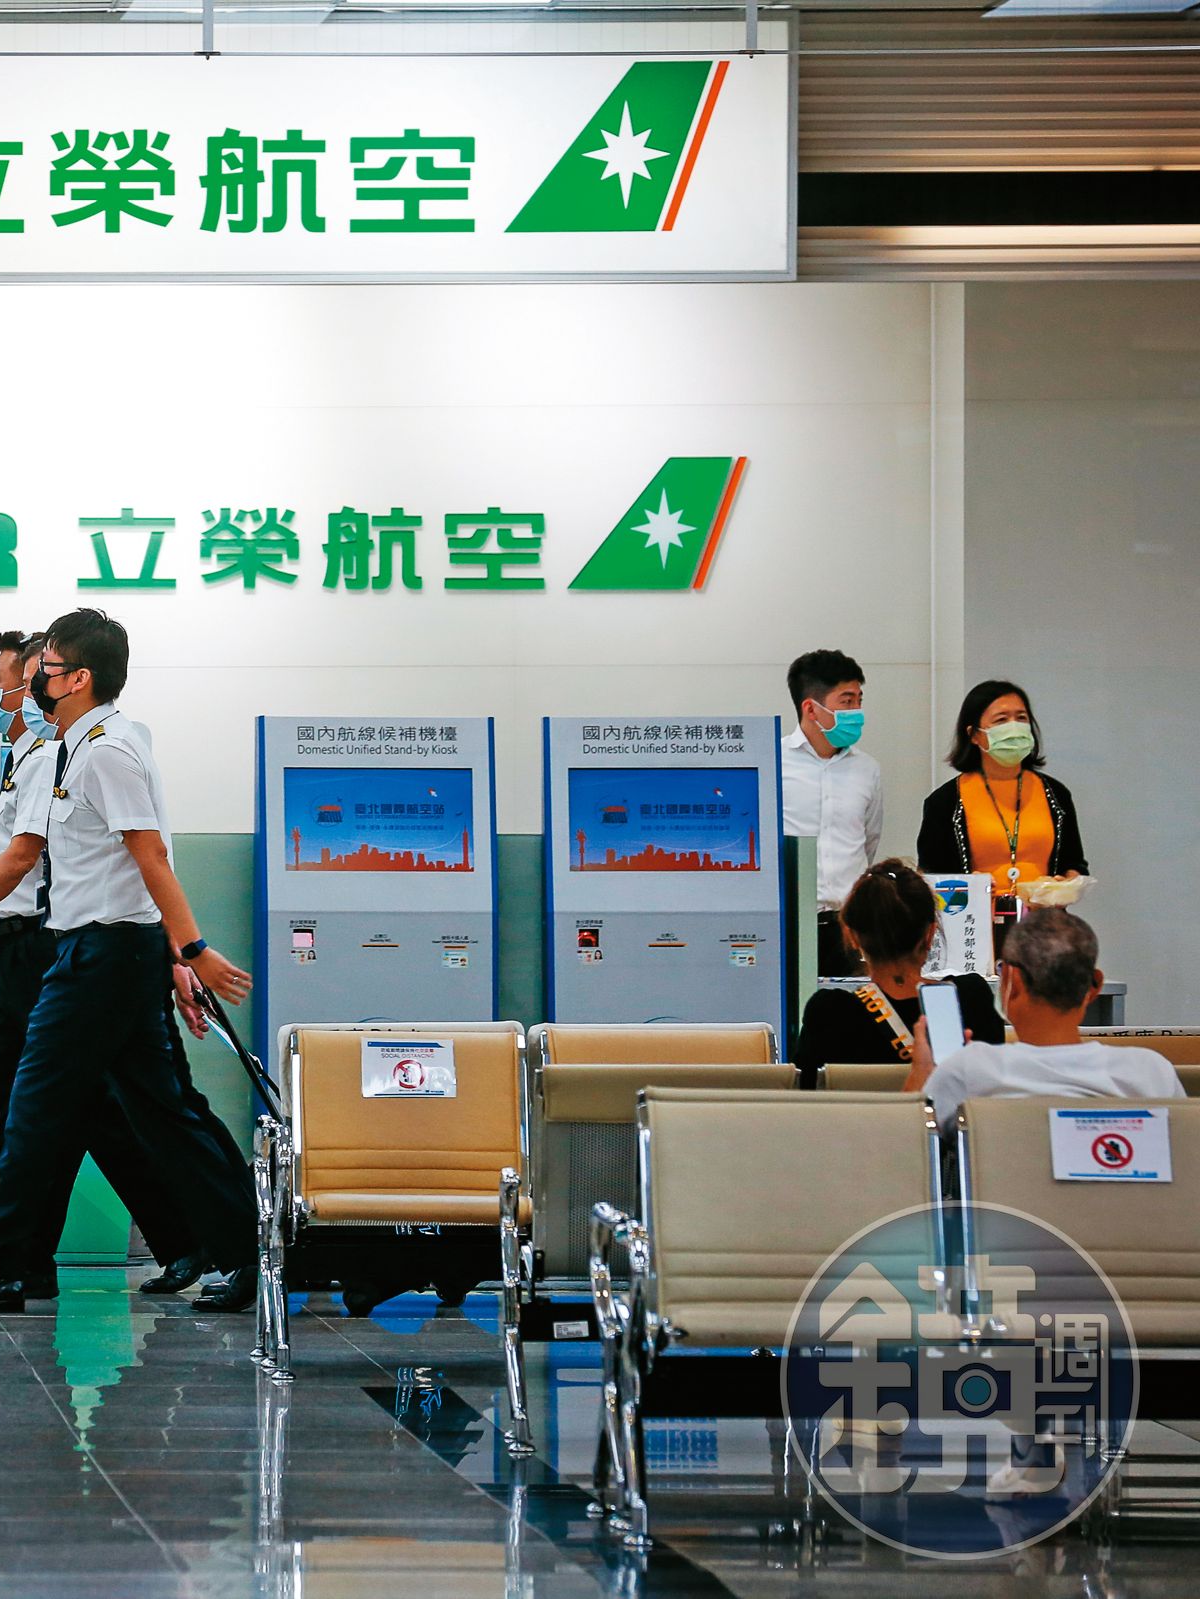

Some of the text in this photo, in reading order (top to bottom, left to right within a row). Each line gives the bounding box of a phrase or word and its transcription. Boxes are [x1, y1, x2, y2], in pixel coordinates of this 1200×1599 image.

[77, 507, 546, 590] 立榮航空
[297, 744, 458, 757] Domestic Unified Stand-by Kiosk
[582, 743, 744, 756] Domestic Unified Stand-by Kiosk
